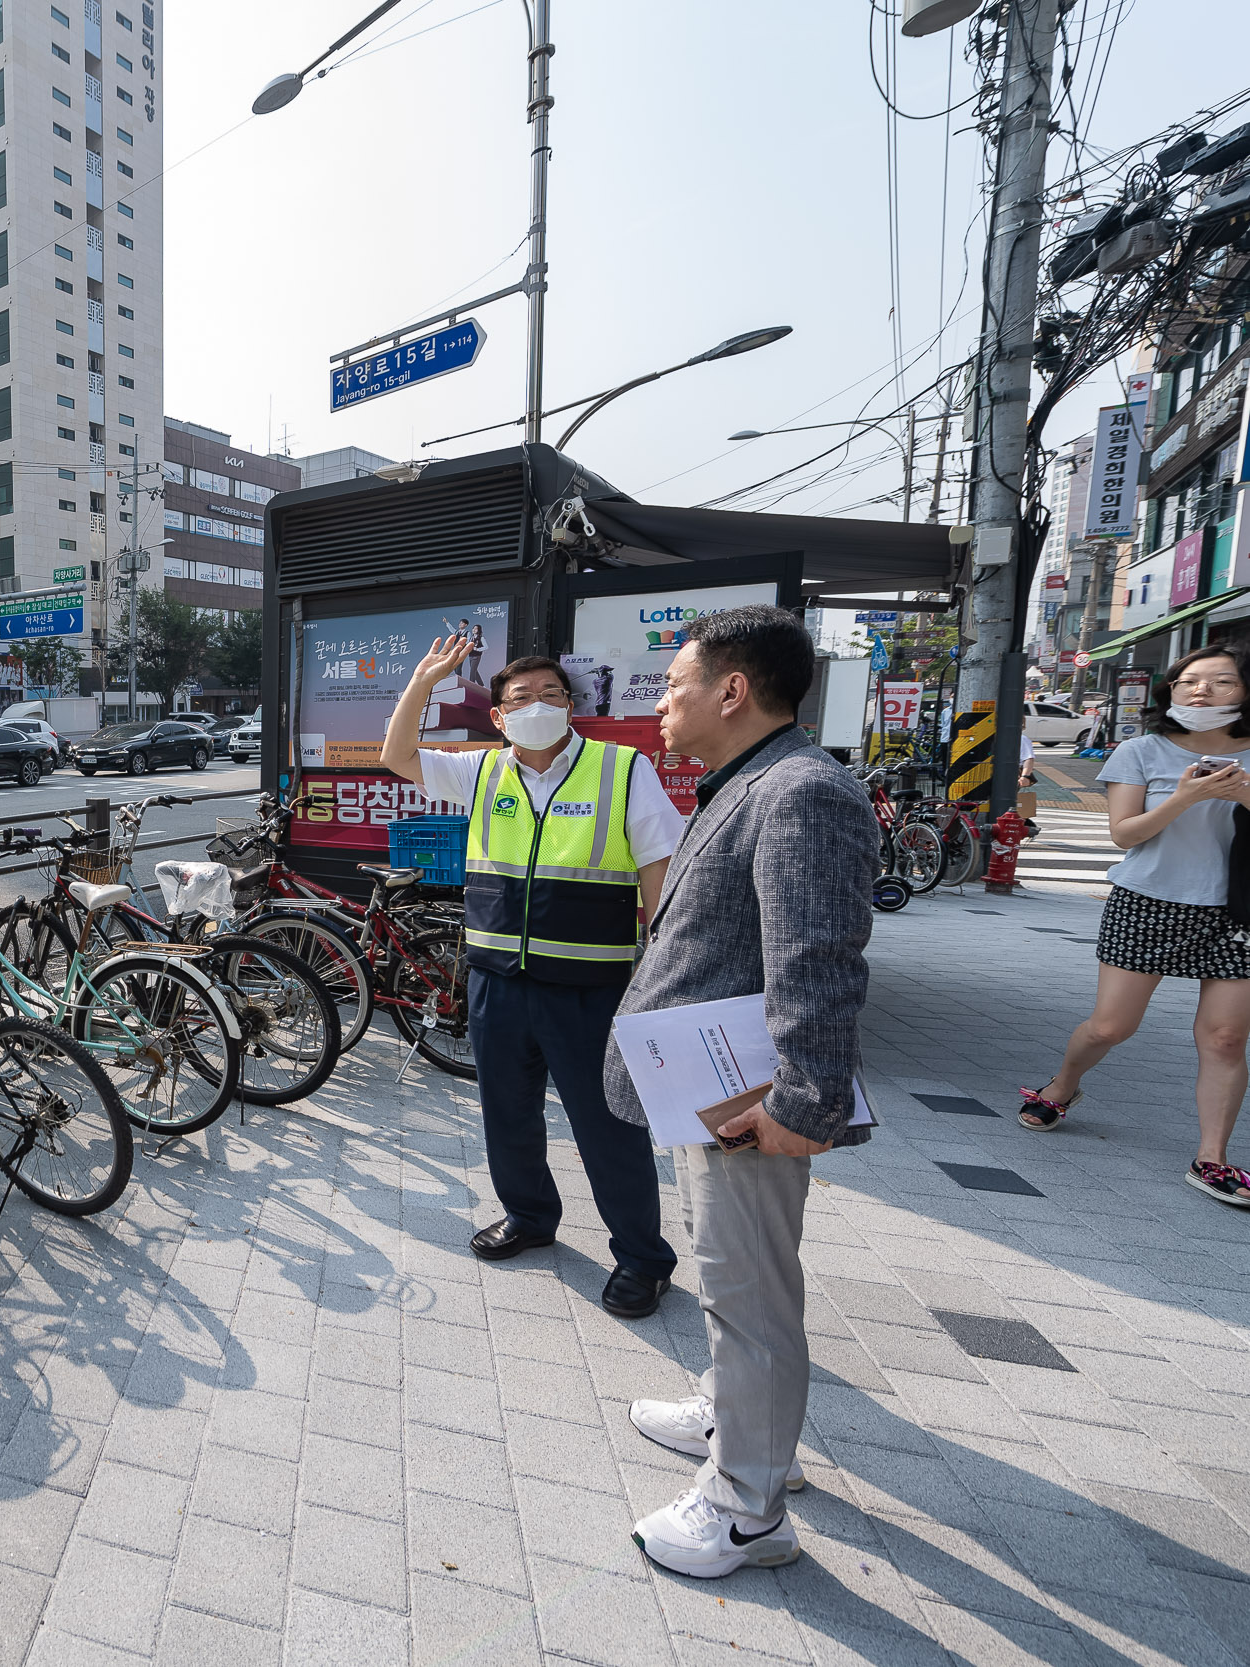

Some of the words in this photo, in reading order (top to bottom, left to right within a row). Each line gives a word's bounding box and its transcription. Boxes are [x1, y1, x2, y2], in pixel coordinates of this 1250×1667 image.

[336, 337, 436, 388] 자양로15길
[335, 382, 380, 405] Jayang-ro
[383, 370, 410, 388] 15-gil
[54, 568, 82, 580] 자양사거리
[25, 613, 53, 625] 아차산로
[25, 625, 54, 634] Achasan-ro
[314, 640, 336, 660] 꿈에
[338, 639, 369, 657] 오르는
[371, 636, 388, 655] 한
[388, 634, 411, 657] 걸음
[629, 673, 663, 685] 즐거운
[883, 700, 918, 728] 약
